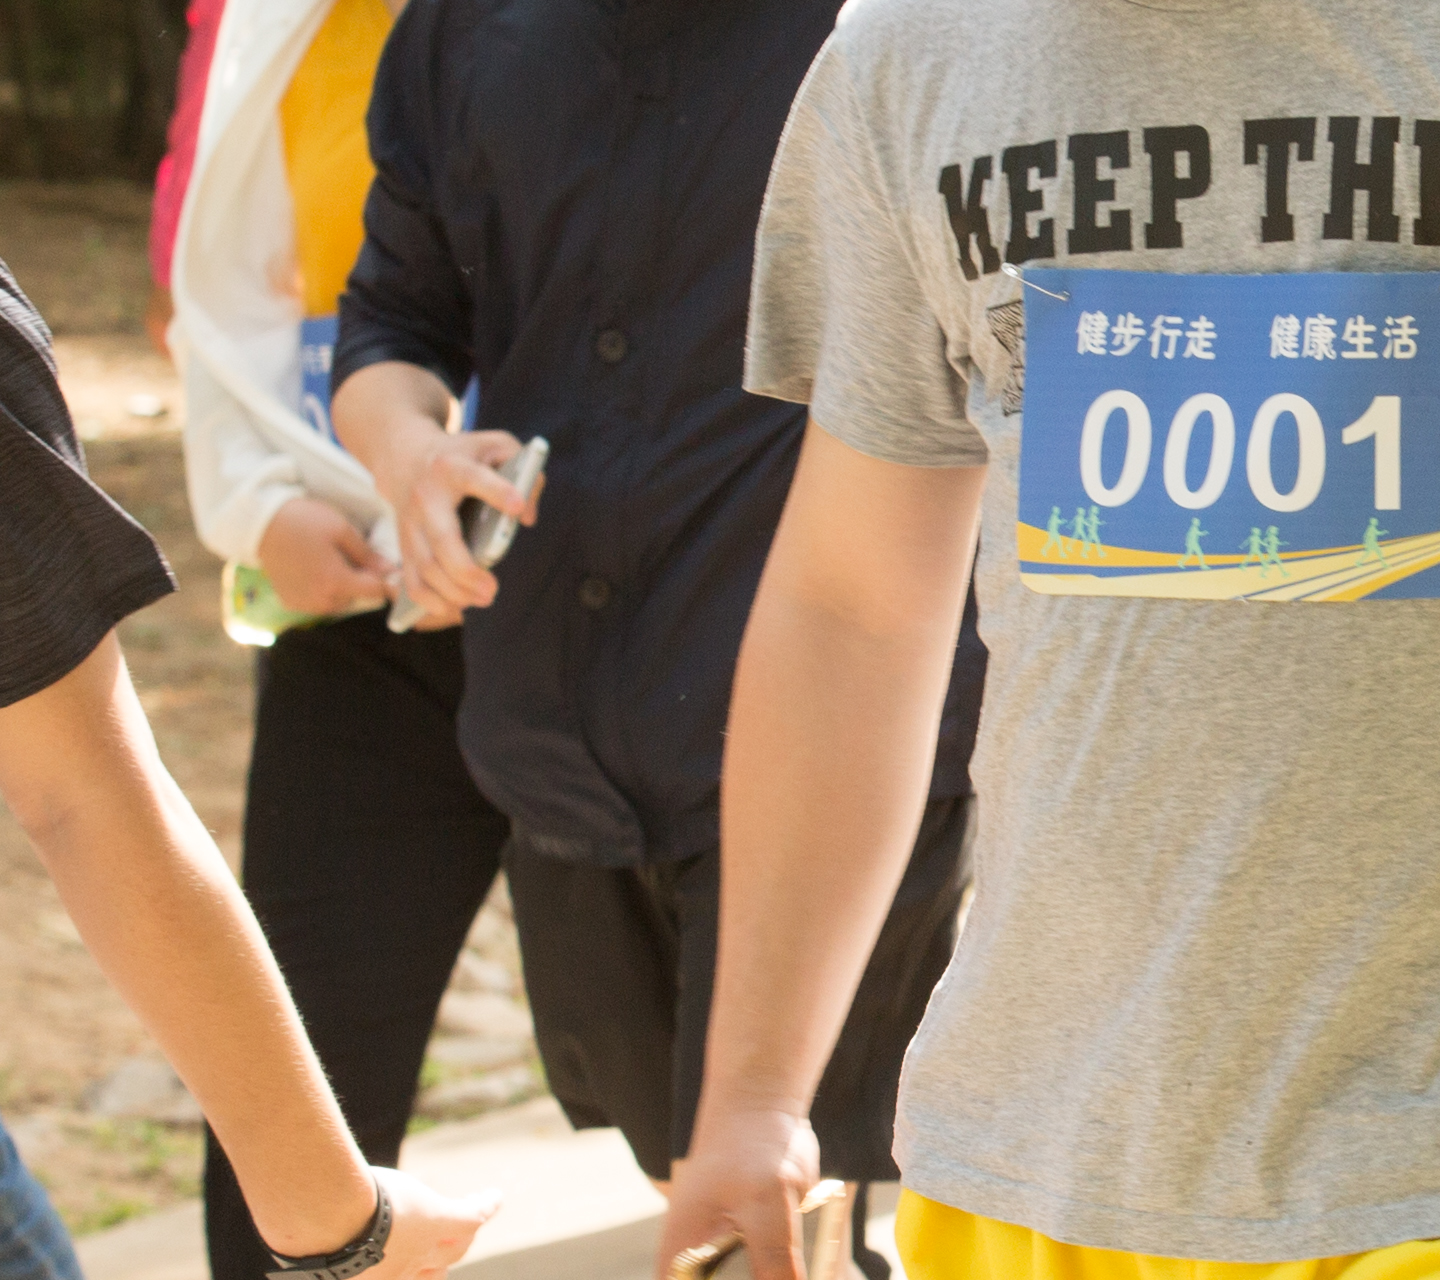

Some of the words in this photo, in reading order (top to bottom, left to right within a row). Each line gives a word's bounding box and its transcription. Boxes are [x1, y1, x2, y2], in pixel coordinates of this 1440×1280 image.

[938, 124, 1212, 280] KEEP
[1075, 310, 1217, 361] 健步行走
[1269, 313, 1419, 362] 健康生活
[1079, 389, 1402, 513] 0001
